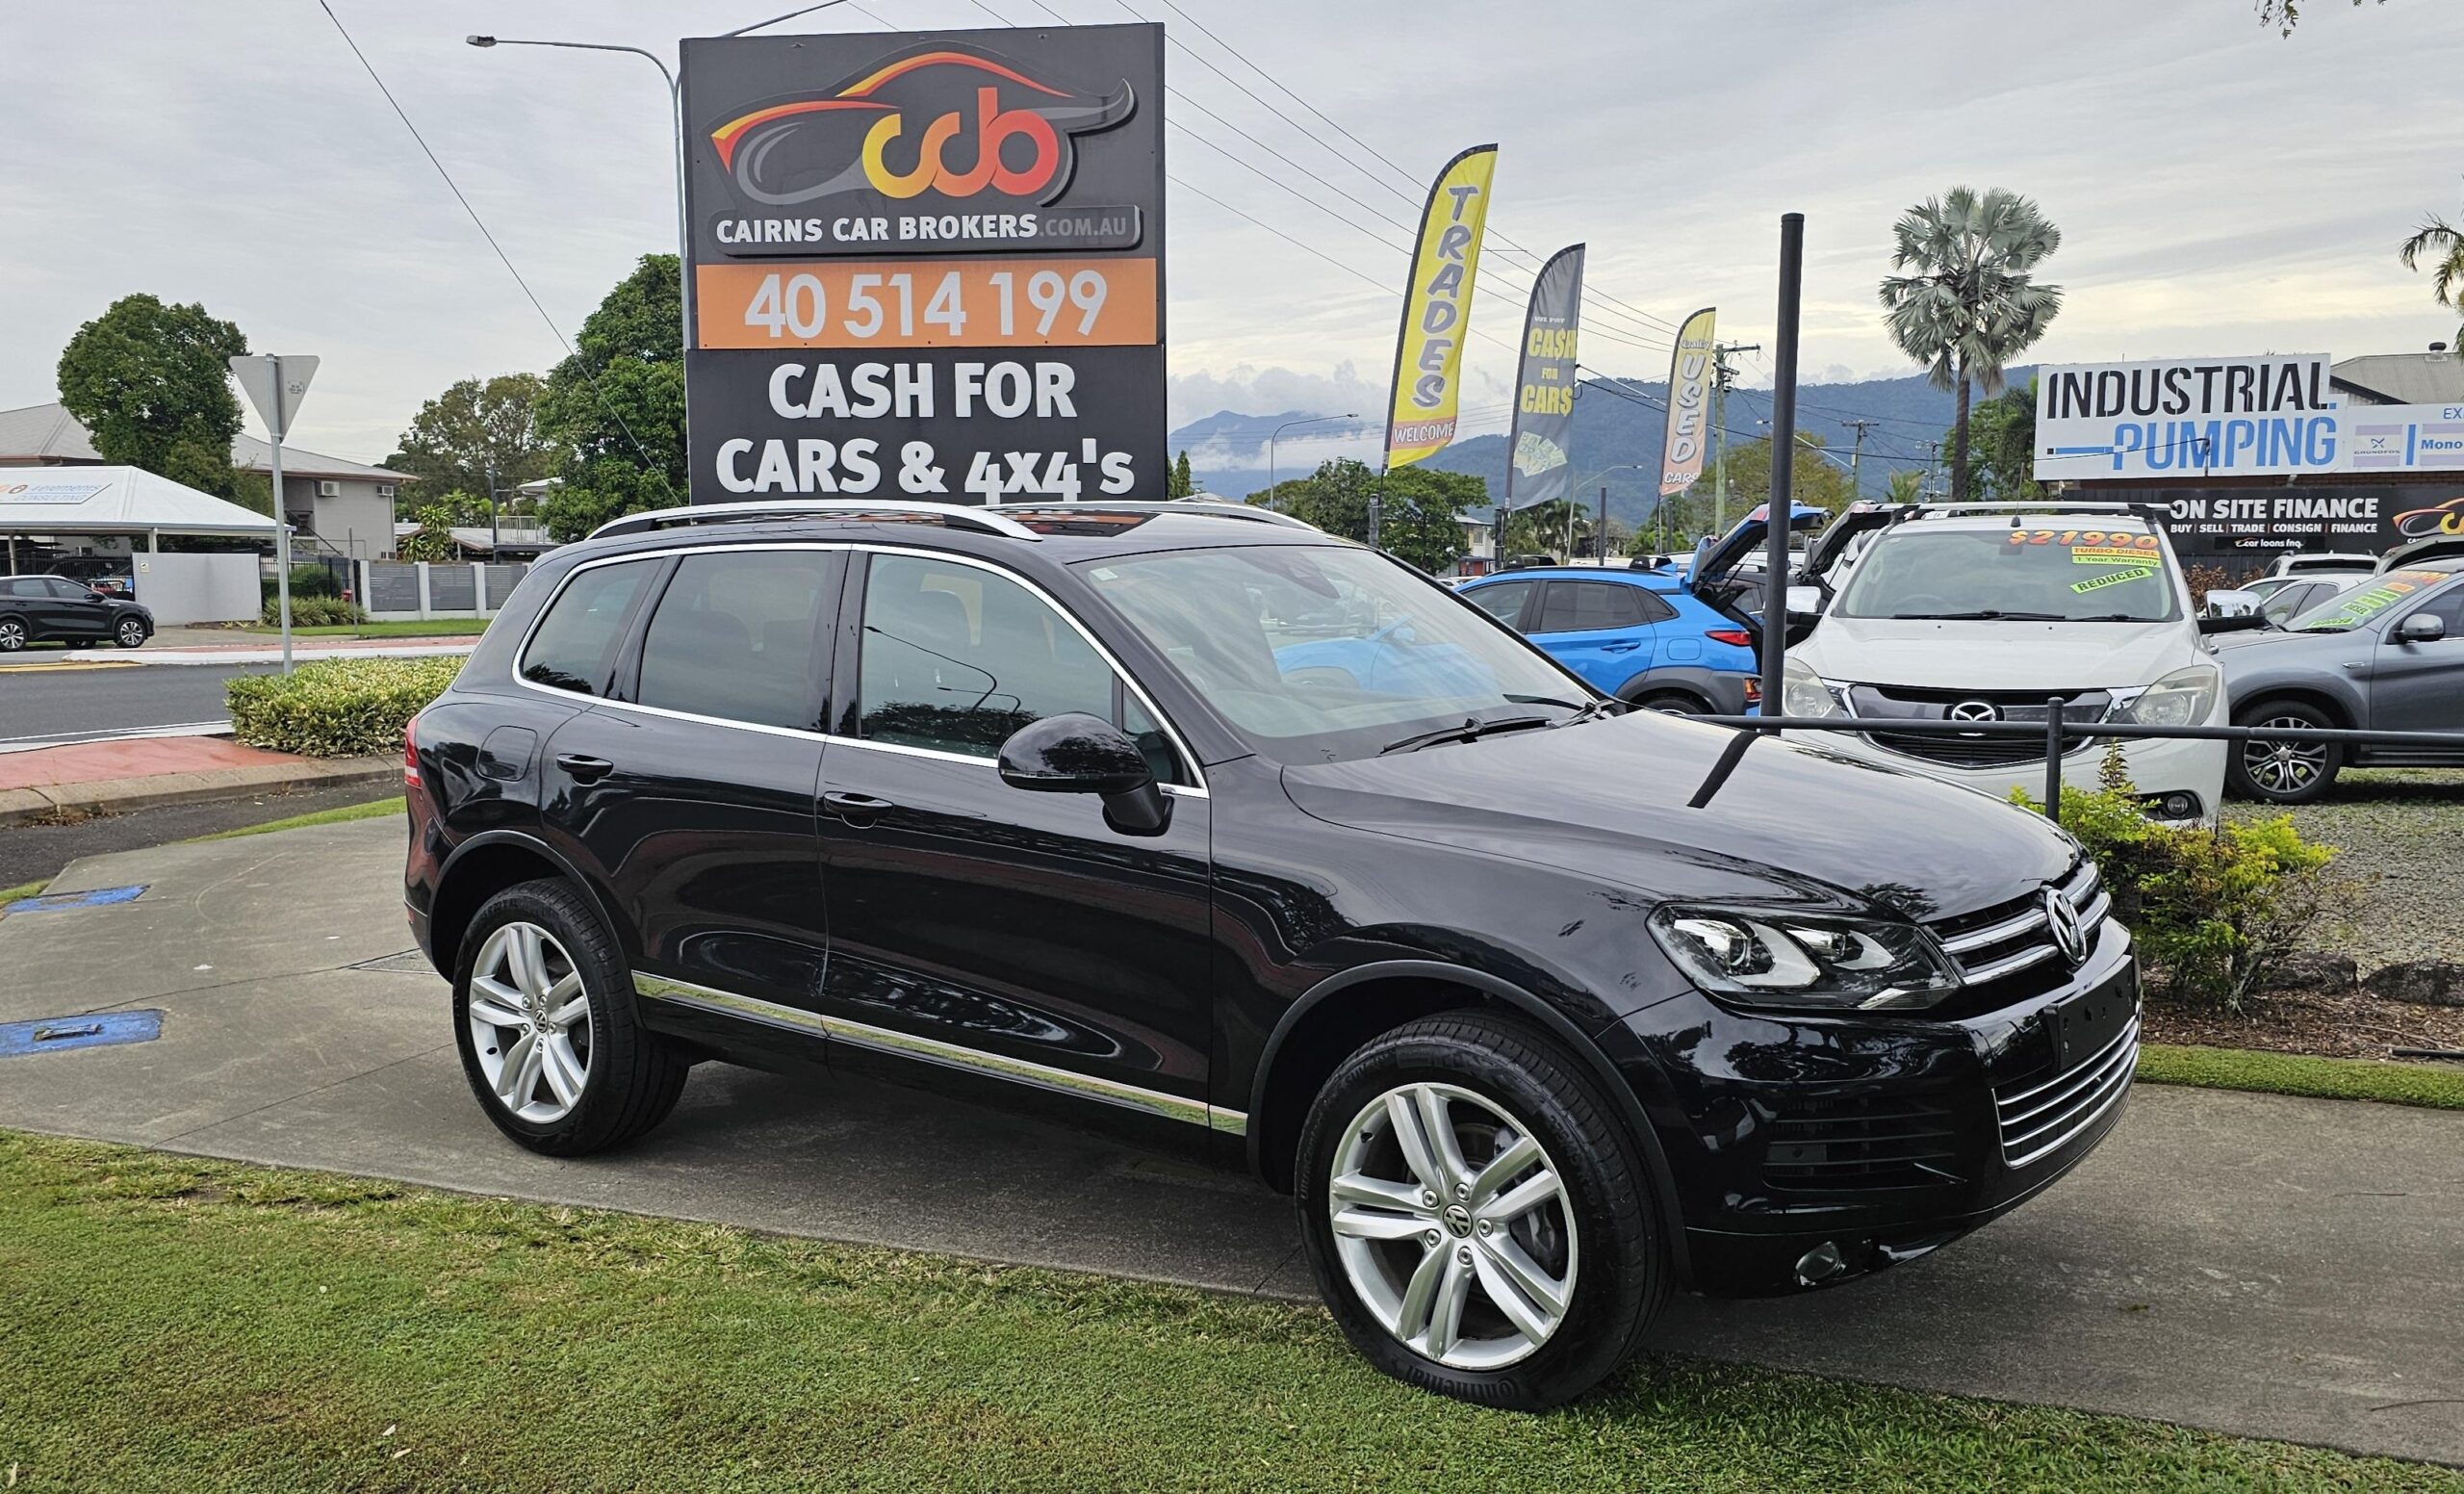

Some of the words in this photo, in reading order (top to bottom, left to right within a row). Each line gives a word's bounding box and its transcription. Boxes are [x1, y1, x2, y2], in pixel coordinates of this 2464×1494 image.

[716, 219, 823, 244] CAIRNS
[833, 216, 889, 242] CAR
[744, 273, 827, 338] 40
[844, 271, 966, 337] 514
[988, 270, 1108, 336] 199
[1412, 186, 1478, 409] TRADES
[1541, 367, 1558, 380] FOR
[769, 362, 935, 419] CASH
[955, 361, 1078, 418] FOR
[2047, 361, 2330, 419] INDUSTRIAL
[1671, 352, 1707, 464] USED
[2443, 407, 2464, 420] EX
[1393, 418, 1455, 444] WELCOME
[2113, 416, 2336, 470] PUMPING
[716, 438, 881, 494] CARS
[898, 441, 949, 493] &
[2170, 500, 2206, 519] ON
[2213, 499, 2267, 519] SITE
[2273, 498, 2378, 519] FINANCE
[2008, 530, 2159, 550] $21990
[2170, 524, 2192, 532] BUY
[2199, 524, 2223, 532] SELL
[2231, 524, 2265, 532] TRADE
[2272, 523, 2322, 532] CONSIGN
[2331, 523, 2376, 532] FINANCE
[2112, 557, 2158, 567] Warranty
[2117, 548, 2158, 557] DIESEL
[2077, 569, 2144, 591] REDUCED
